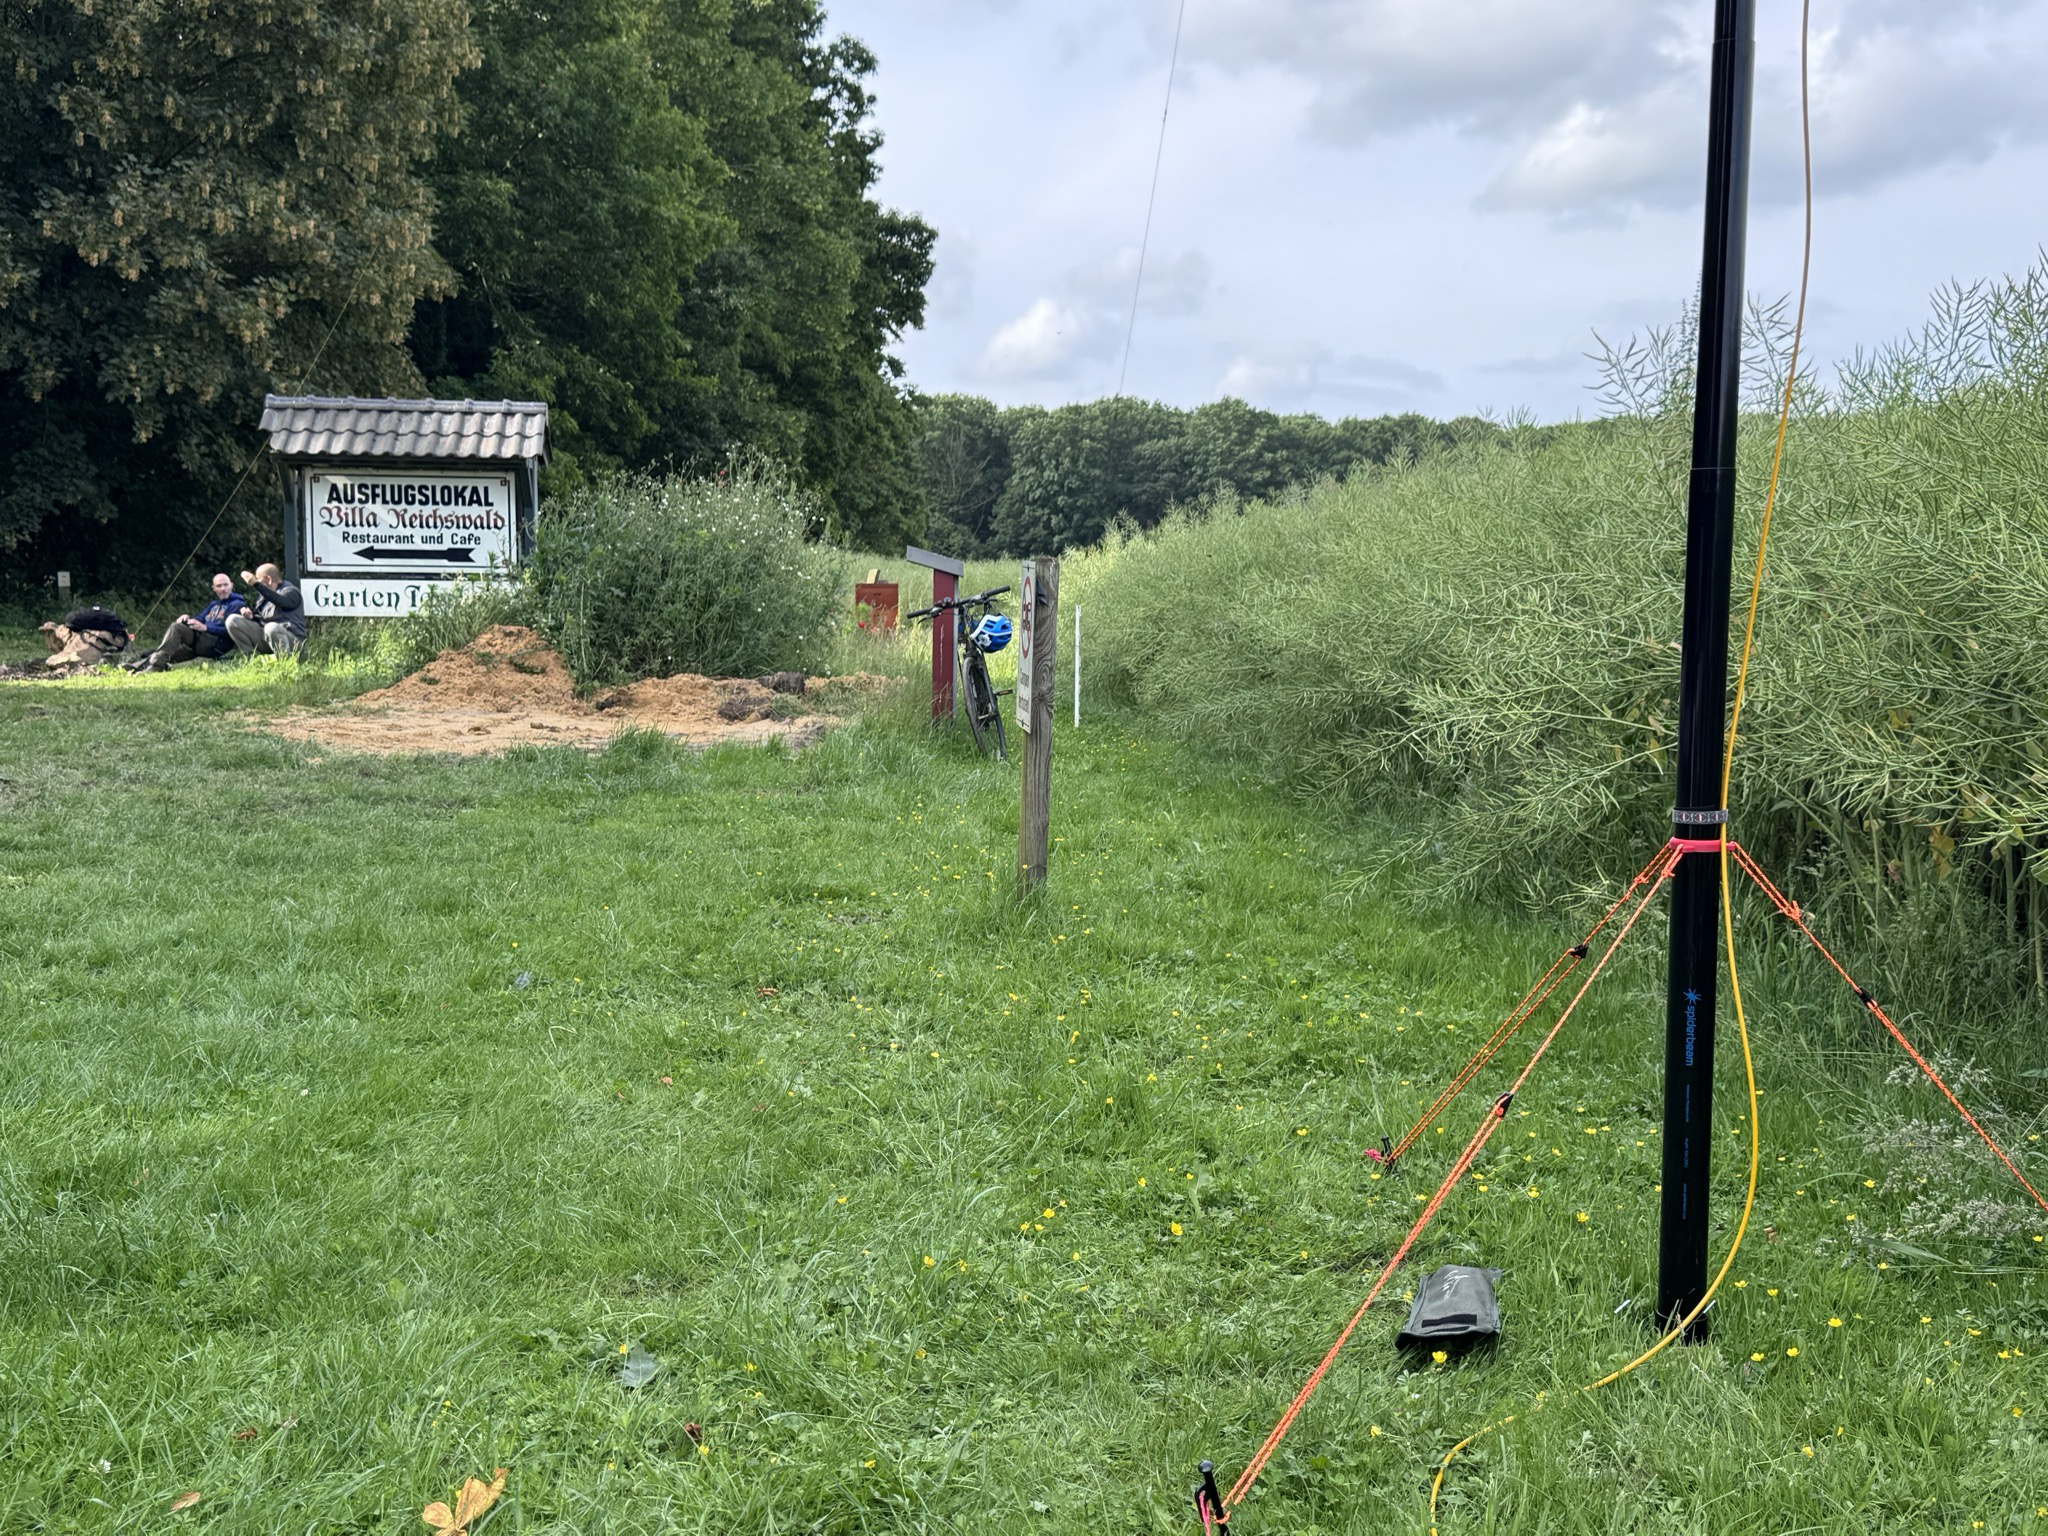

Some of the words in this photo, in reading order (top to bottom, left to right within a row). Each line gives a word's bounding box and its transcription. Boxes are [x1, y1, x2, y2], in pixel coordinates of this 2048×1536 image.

[327, 483, 494, 507] AUSFLUGSLOKAL
[319, 506, 380, 528] Villa
[388, 508, 506, 533] Reichswald
[342, 531, 415, 544] Restaurant
[421, 533, 443, 545] und
[451, 533, 481, 545] Cafe
[314, 583, 400, 612] Garten
[1684, 1005, 1696, 1067] spiderbeam
